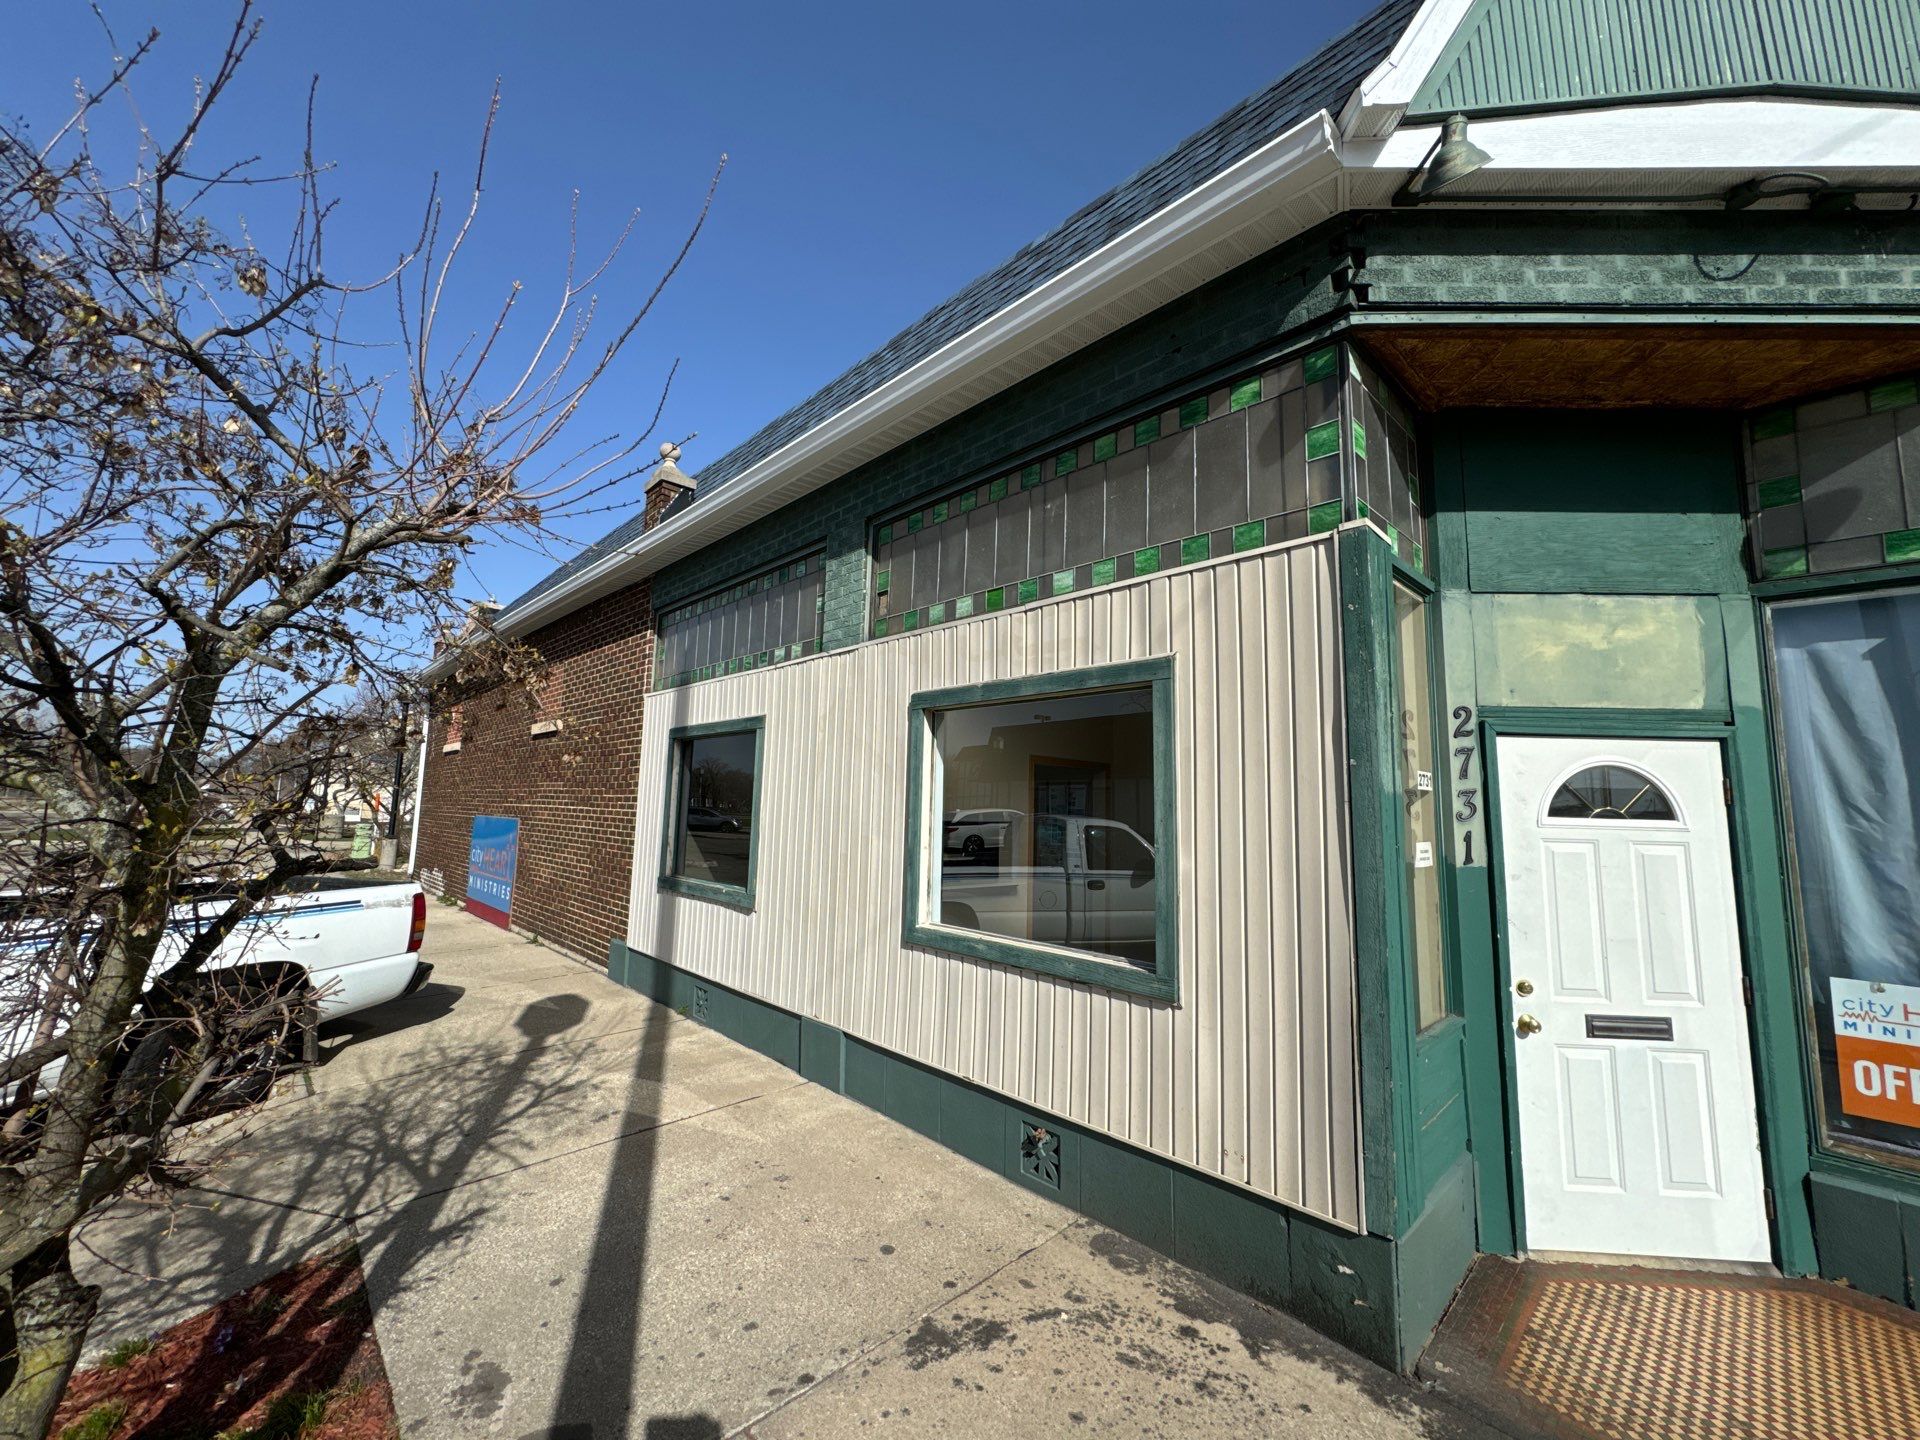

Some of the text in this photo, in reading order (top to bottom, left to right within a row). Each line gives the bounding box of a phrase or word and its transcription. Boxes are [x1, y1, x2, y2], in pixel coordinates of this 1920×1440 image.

[1453, 705, 1478, 866] 2731
[468, 875, 511, 900] MINISTRIES
[1842, 998, 1894, 1018] city
[1843, 1020, 1912, 1040] MINI
